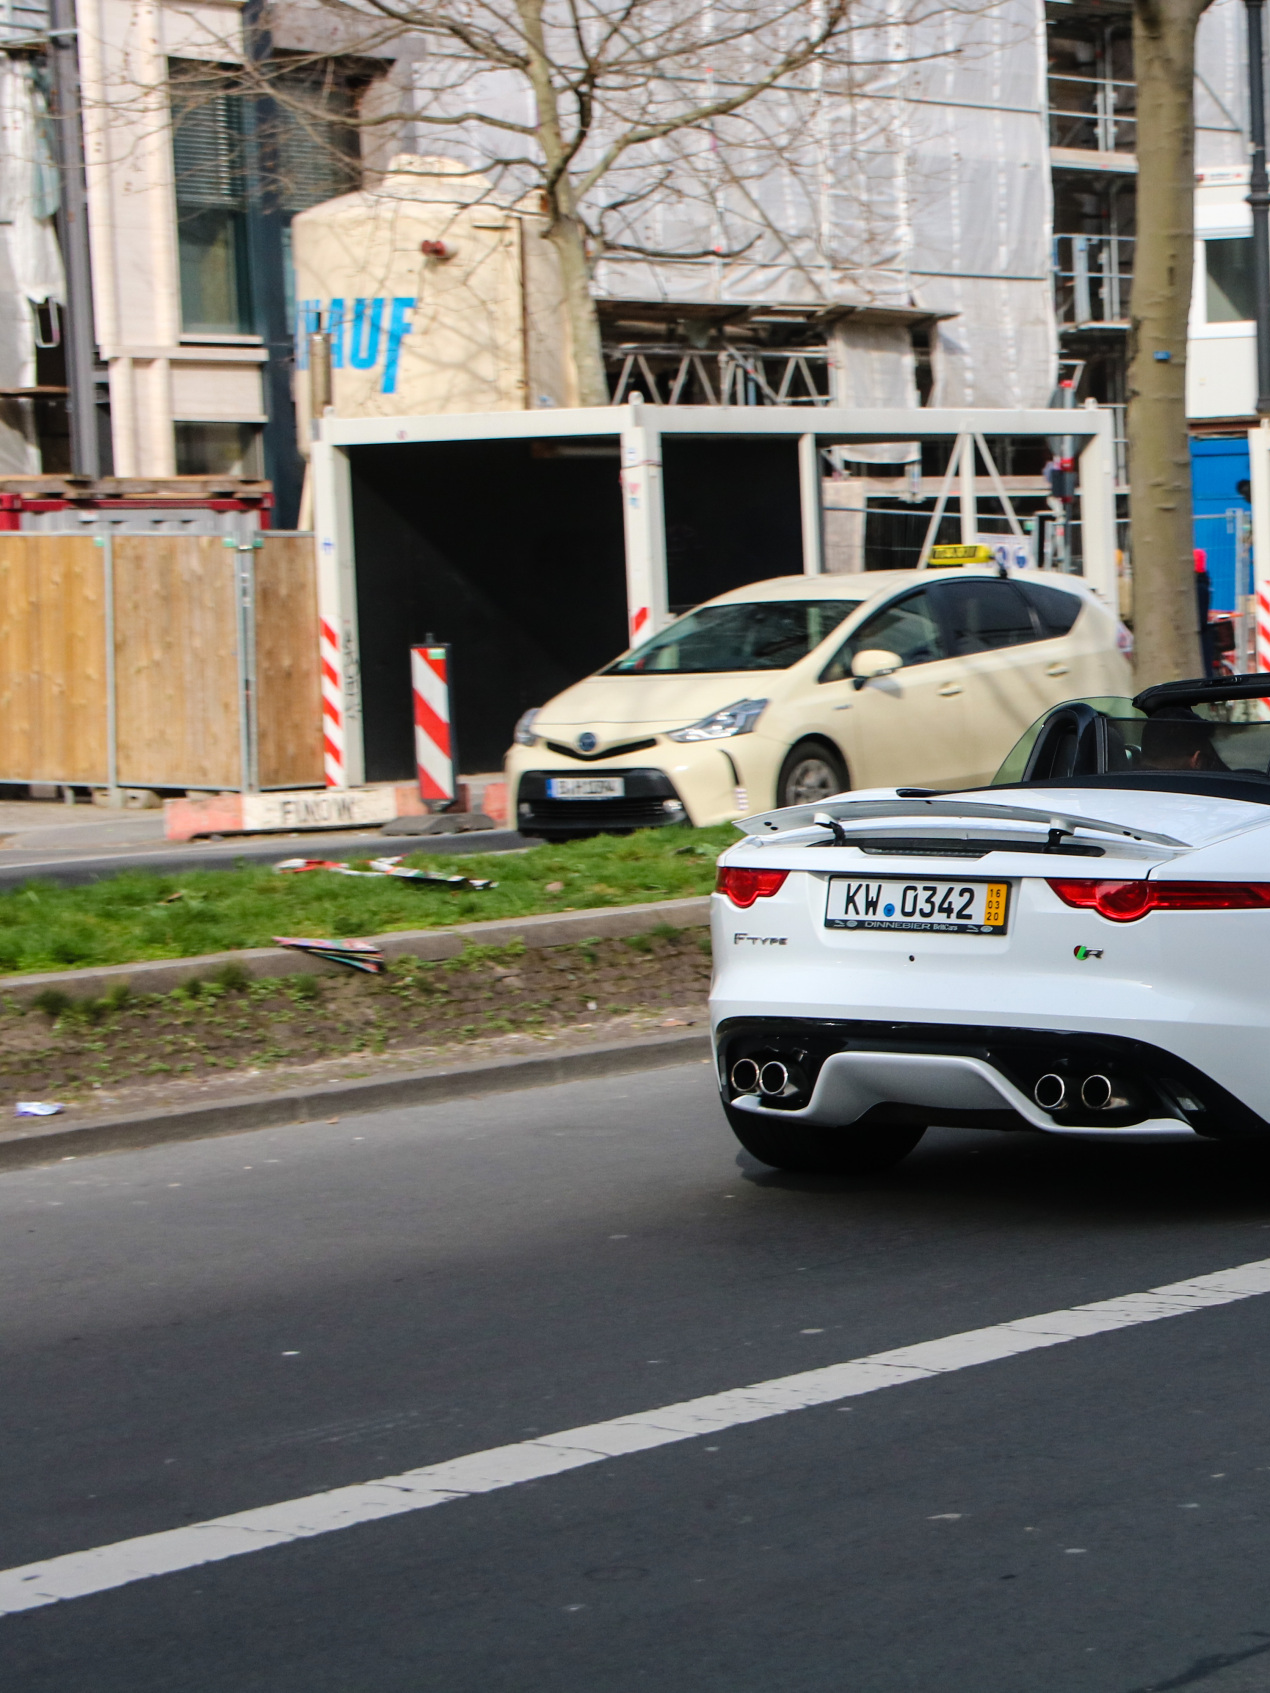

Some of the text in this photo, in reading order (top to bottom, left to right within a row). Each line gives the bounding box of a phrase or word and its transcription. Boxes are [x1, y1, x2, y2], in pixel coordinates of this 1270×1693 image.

[990, 888, 1001, 898] 16
[844, 883, 975, 920] KW 0342
[988, 900, 1000, 910] 03
[987, 911, 999, 921] 20
[865, 920, 931, 931] DINNEBIER
